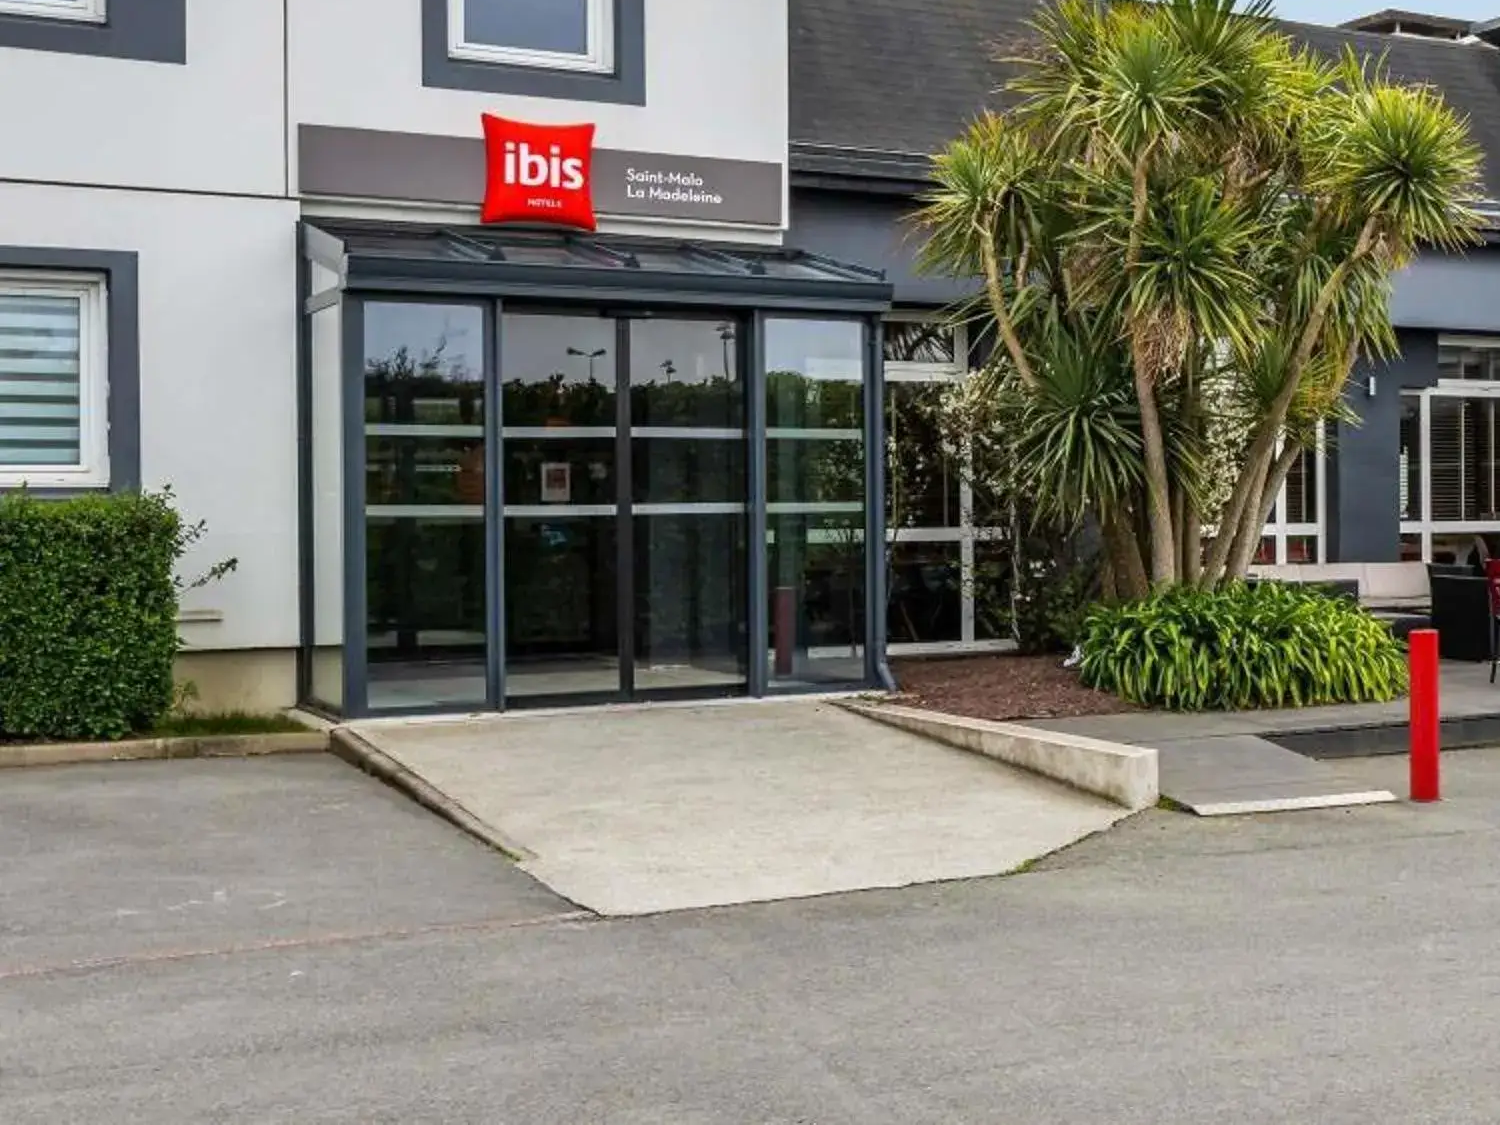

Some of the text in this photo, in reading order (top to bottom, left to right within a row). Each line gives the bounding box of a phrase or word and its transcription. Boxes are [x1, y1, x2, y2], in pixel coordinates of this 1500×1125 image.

[504, 141, 585, 190] ibis
[626, 167, 704, 187] Saint-Malo
[627, 184, 723, 204] La Madeleine
